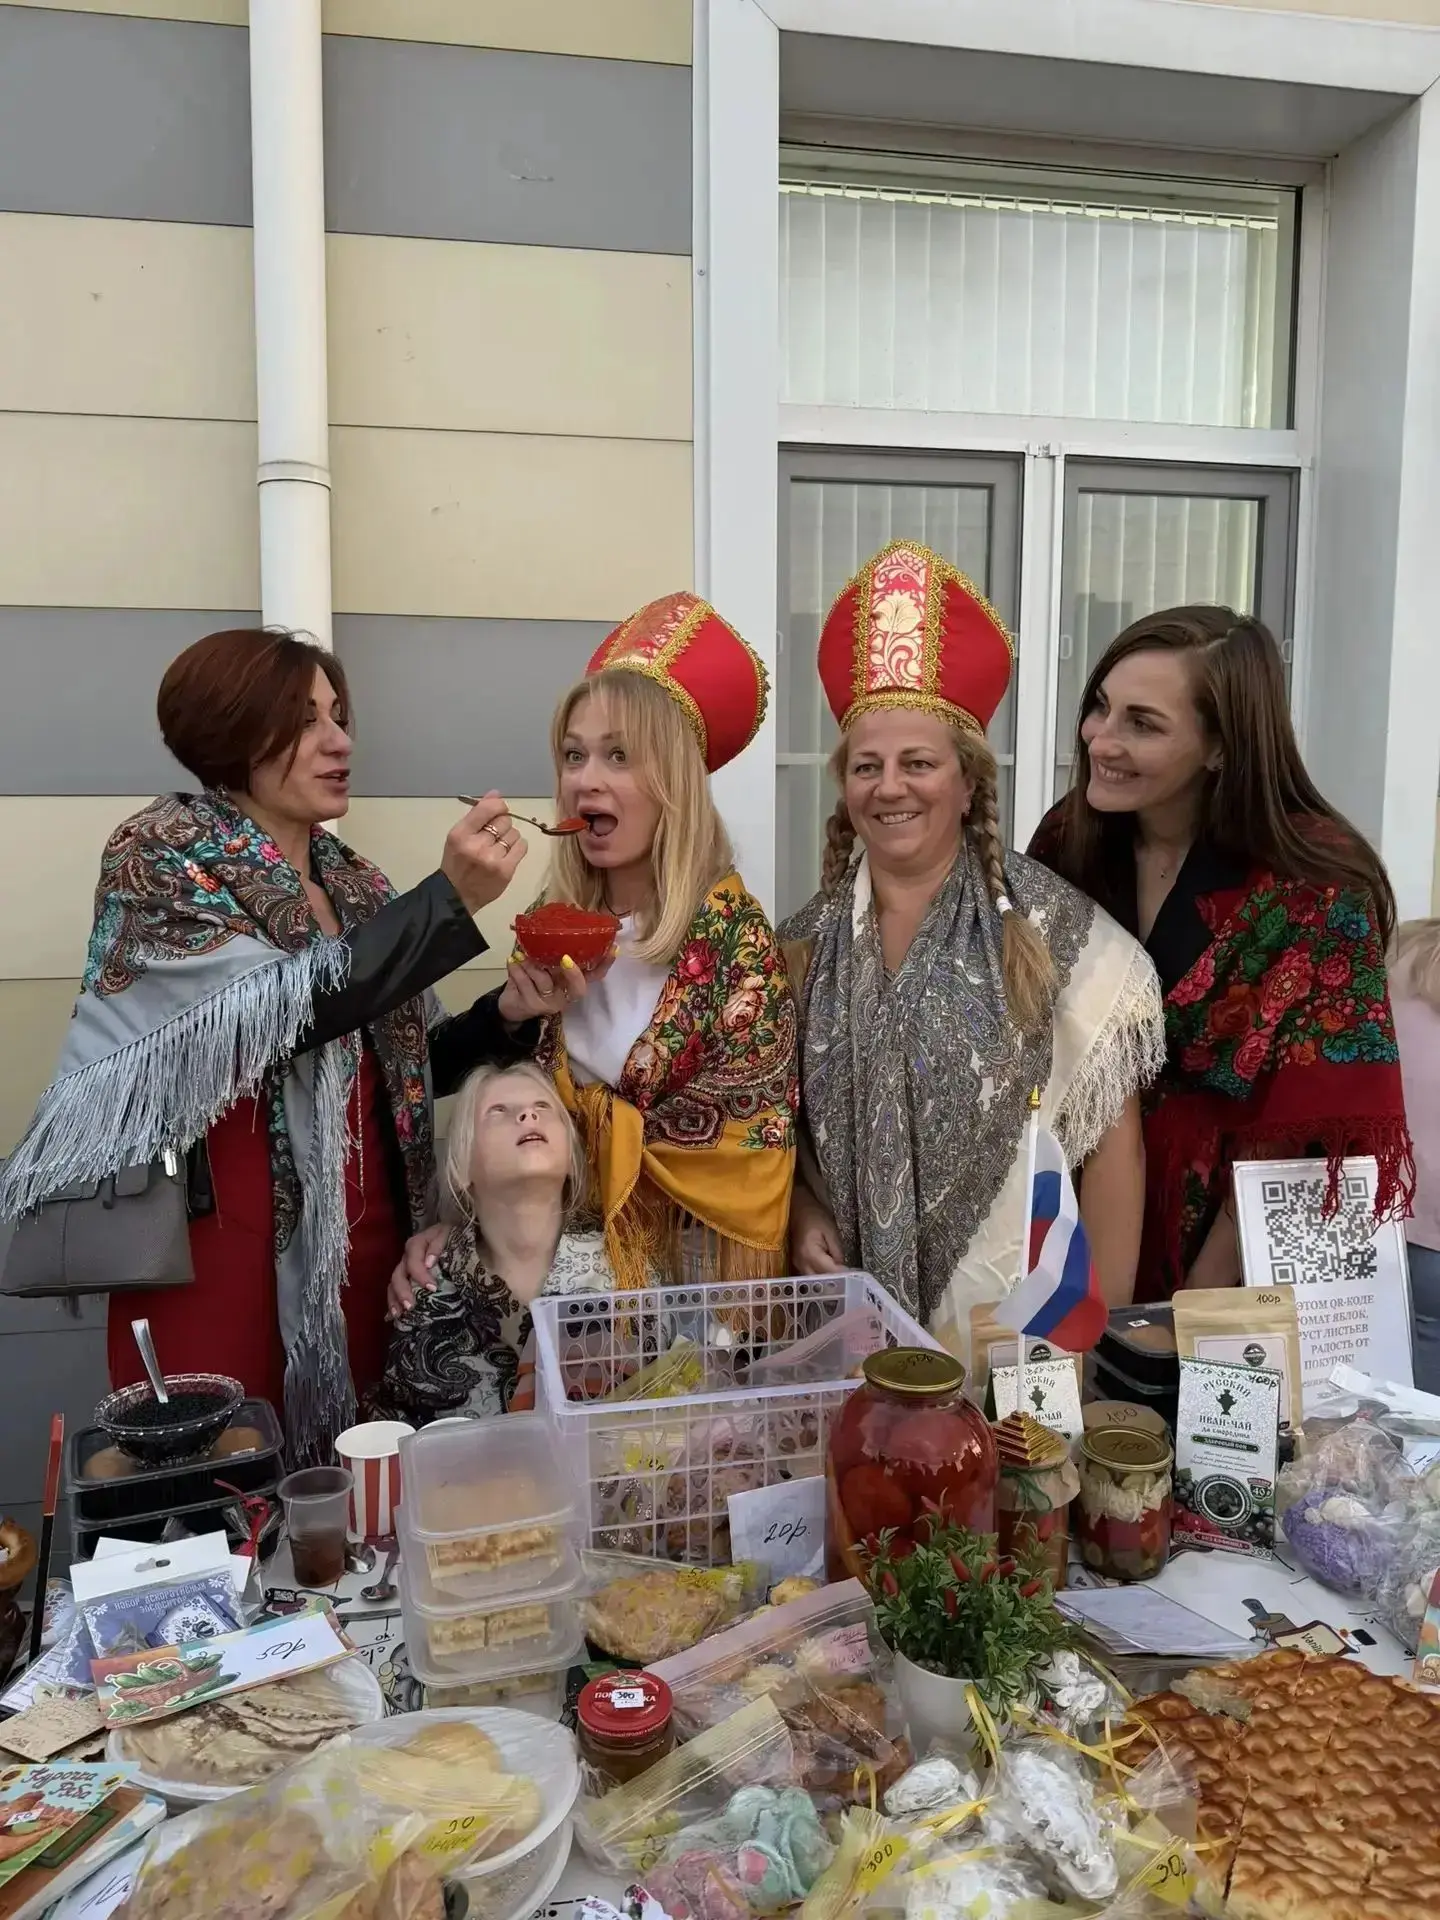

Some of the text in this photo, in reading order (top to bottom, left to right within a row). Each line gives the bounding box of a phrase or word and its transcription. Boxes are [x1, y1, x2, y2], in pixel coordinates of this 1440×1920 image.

[1322, 1324, 1369, 1338] ЛИСТЬЕВ
[1311, 1338, 1370, 1354] РАДОСТЬ ОТ
[1202, 1378, 1252, 1398] РУССКИЙ
